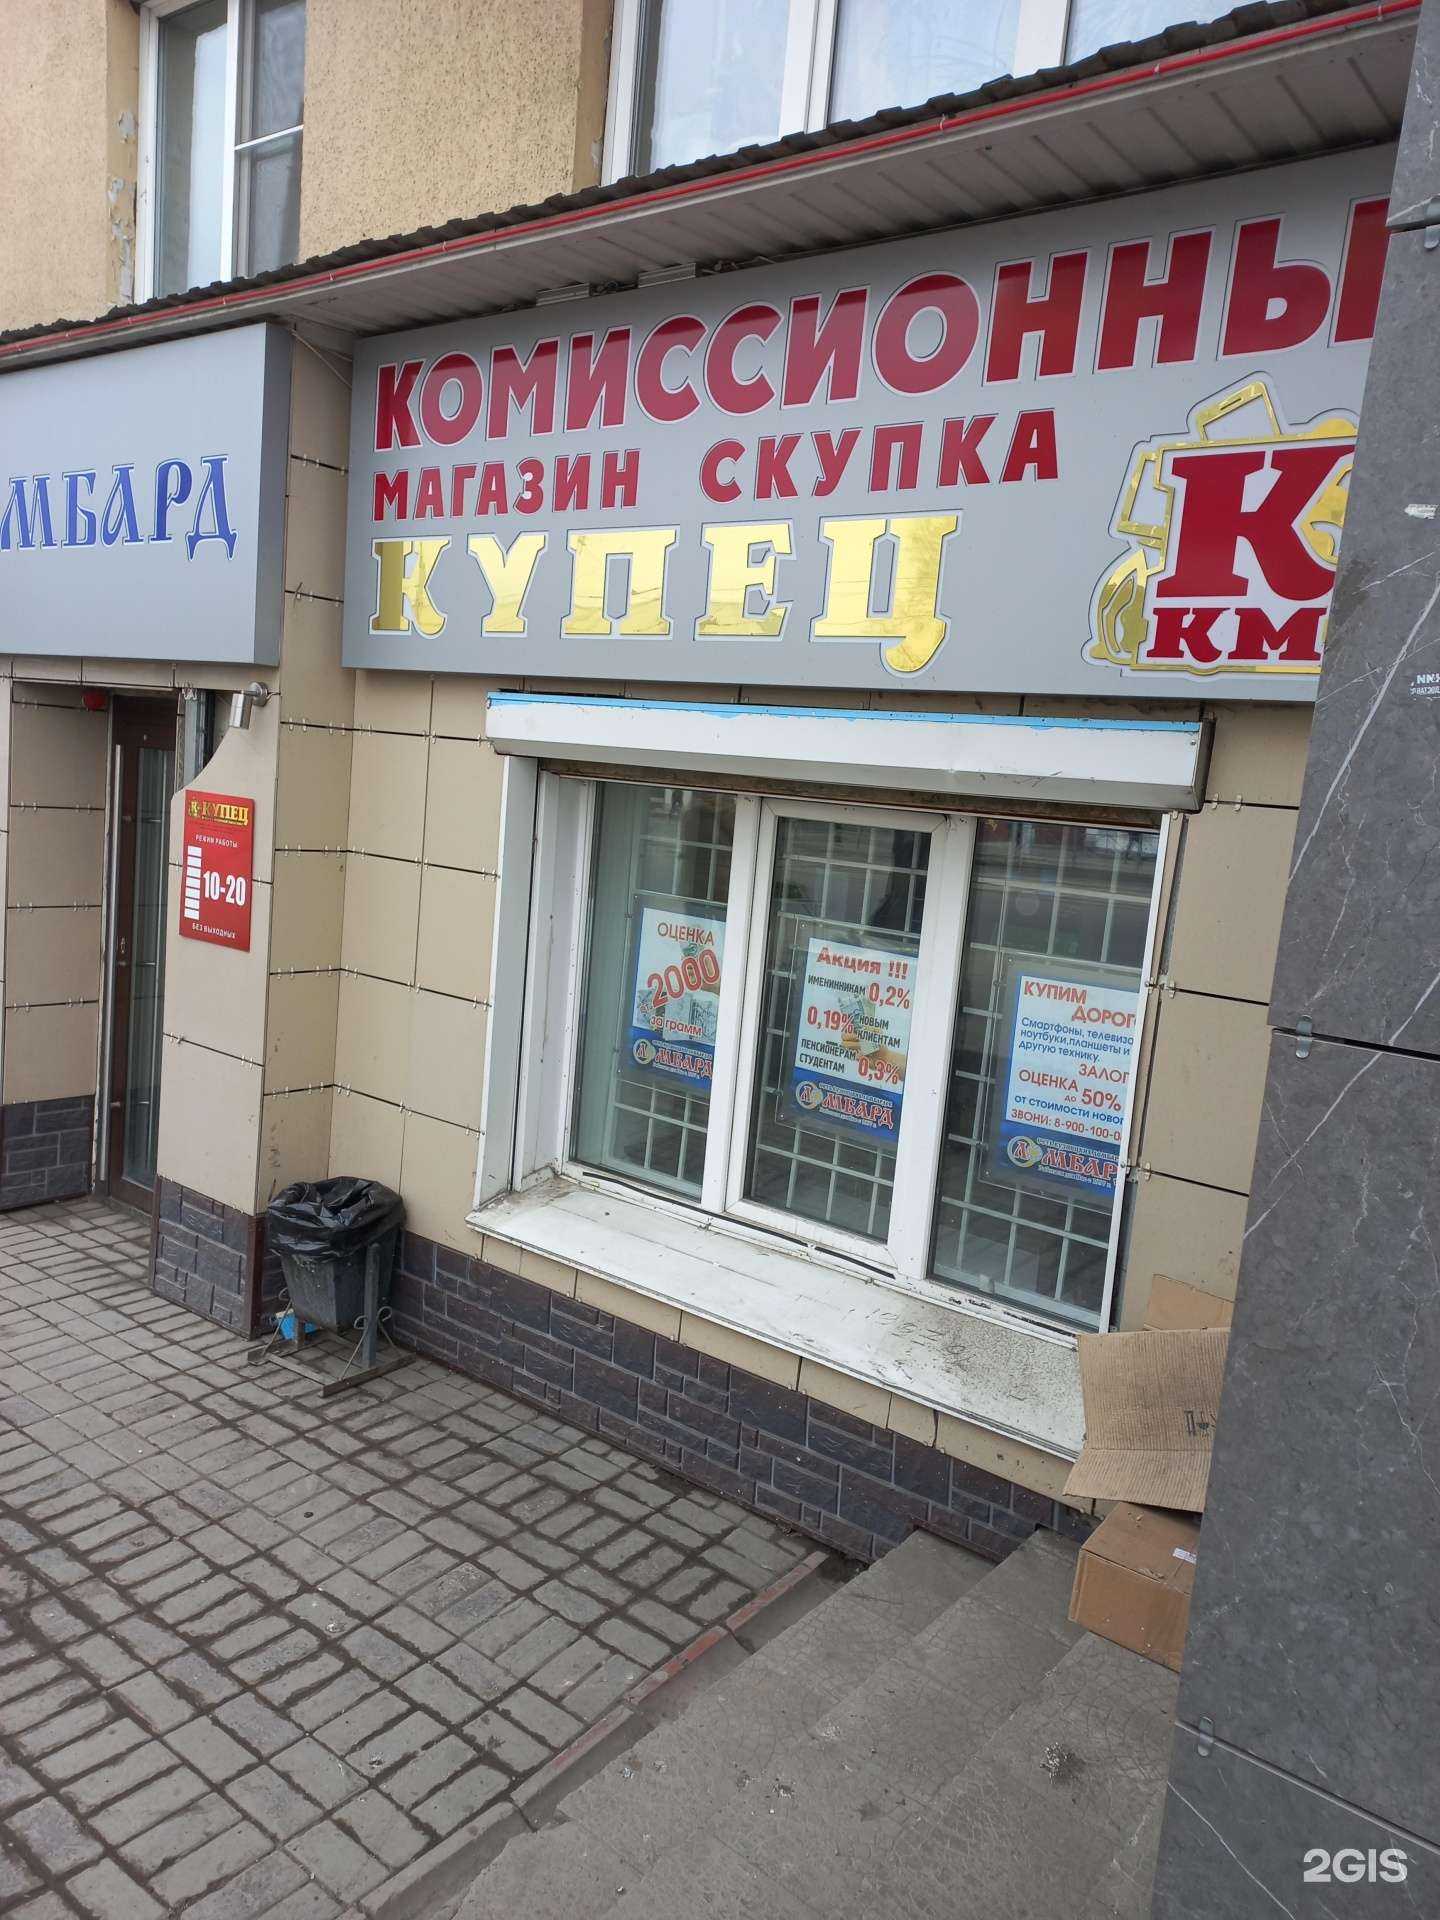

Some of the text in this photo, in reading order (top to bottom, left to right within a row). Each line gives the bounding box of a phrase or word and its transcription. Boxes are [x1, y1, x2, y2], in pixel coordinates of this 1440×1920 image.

[372, 408, 1060, 522] МАГАЗИН СКУПКА
[369, 509, 962, 672] КУПЕЦ
[202, 801, 249, 826] КУПЕЦ
[215, 836, 238, 849] РАБОТЫ
[203, 870, 247, 907] 10-20
[192, 922, 236, 939] БЕЗ ВЫХОДНЫХ
[657, 921, 716, 946] ОЦЕНКА
[646, 949, 721, 1010] 2000
[808, 974, 910, 1010] ИМЕНИННИКАМ 0,2%
[1023, 980, 1088, 1005] КУПИМ
[650, 1015, 703, 1037] за грамм
[807, 1005, 890, 1035] 0,19% НОВЫМ
[1021, 1017, 1085, 1038] Смартфоны,
[1071, 1005, 1137, 1028] ДОРОГ
[857, 1030, 901, 1049] КЛИЕНТАМ
[1123, 1047, 1131, 1056] и
[1019, 1041, 1101, 1064] другую технику.
[799, 1053, 900, 1085] СТУДЕНТАМ 0,3%
[1018, 1069, 1079, 1092] ОЦЕНКА
[1078, 1063, 1130, 1085] ЗАЛОГ
[1081, 1088, 1122, 1112] 50%
[1011, 1108, 1123, 1140] ЗВОНИ: 8-900-100-0
